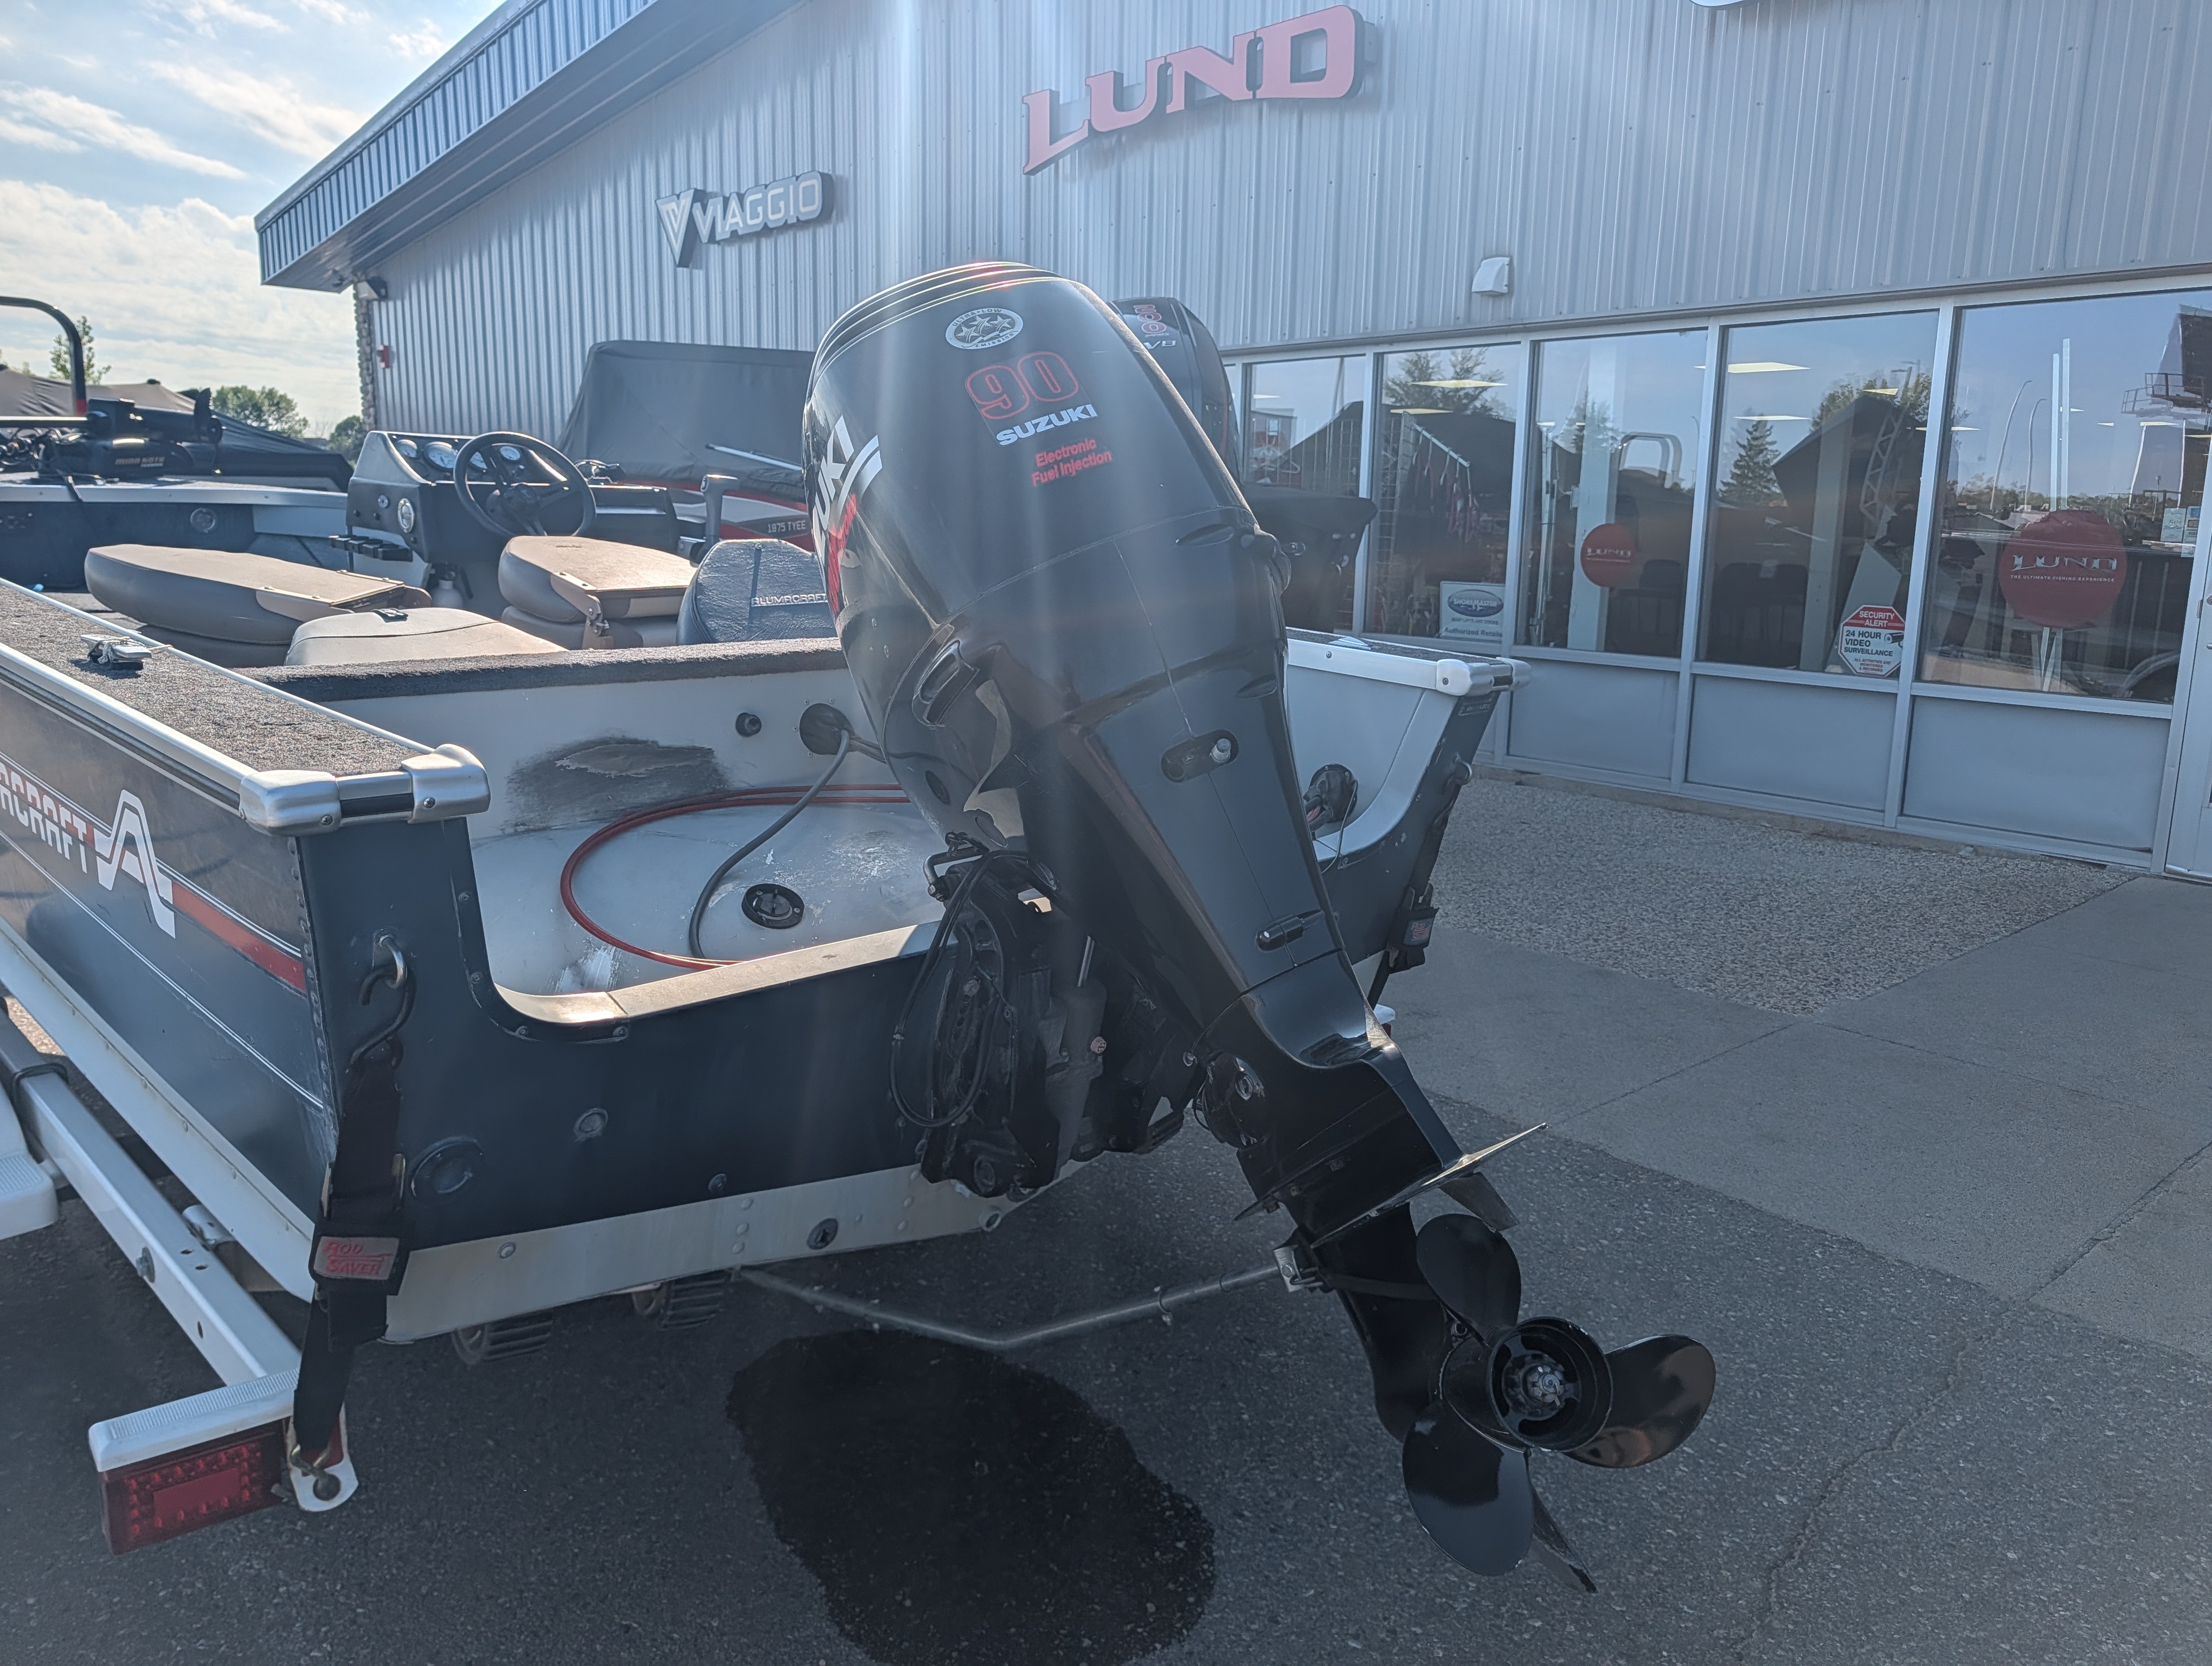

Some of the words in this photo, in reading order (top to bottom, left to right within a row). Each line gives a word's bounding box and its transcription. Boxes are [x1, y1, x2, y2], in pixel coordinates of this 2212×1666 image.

[1022, 5, 1355, 175] LUND
[694, 178, 820, 239] VIAGGIO
[965, 351, 1079, 420] 90
[996, 404, 1098, 445] SUZUKI
[1035, 438, 1097, 467] Electronic
[1031, 465, 1059, 486] Fuel
[1060, 451, 1112, 476] Injection
[768, 523, 786, 533] 1875
[787, 520, 807, 531] TYEE
[2011, 555, 2117, 572] LUND
[751, 593, 827, 605] ALUMACRAFT
[1859, 611, 1895, 619] SECURITY
[1444, 627, 1479, 636] Authorized
[1481, 630, 1503, 638] Retaile
[1858, 631, 1881, 639] HOUR
[1845, 638, 1871, 647] VIDEO
[1844, 646, 1894, 657] SURVEILLANCE
